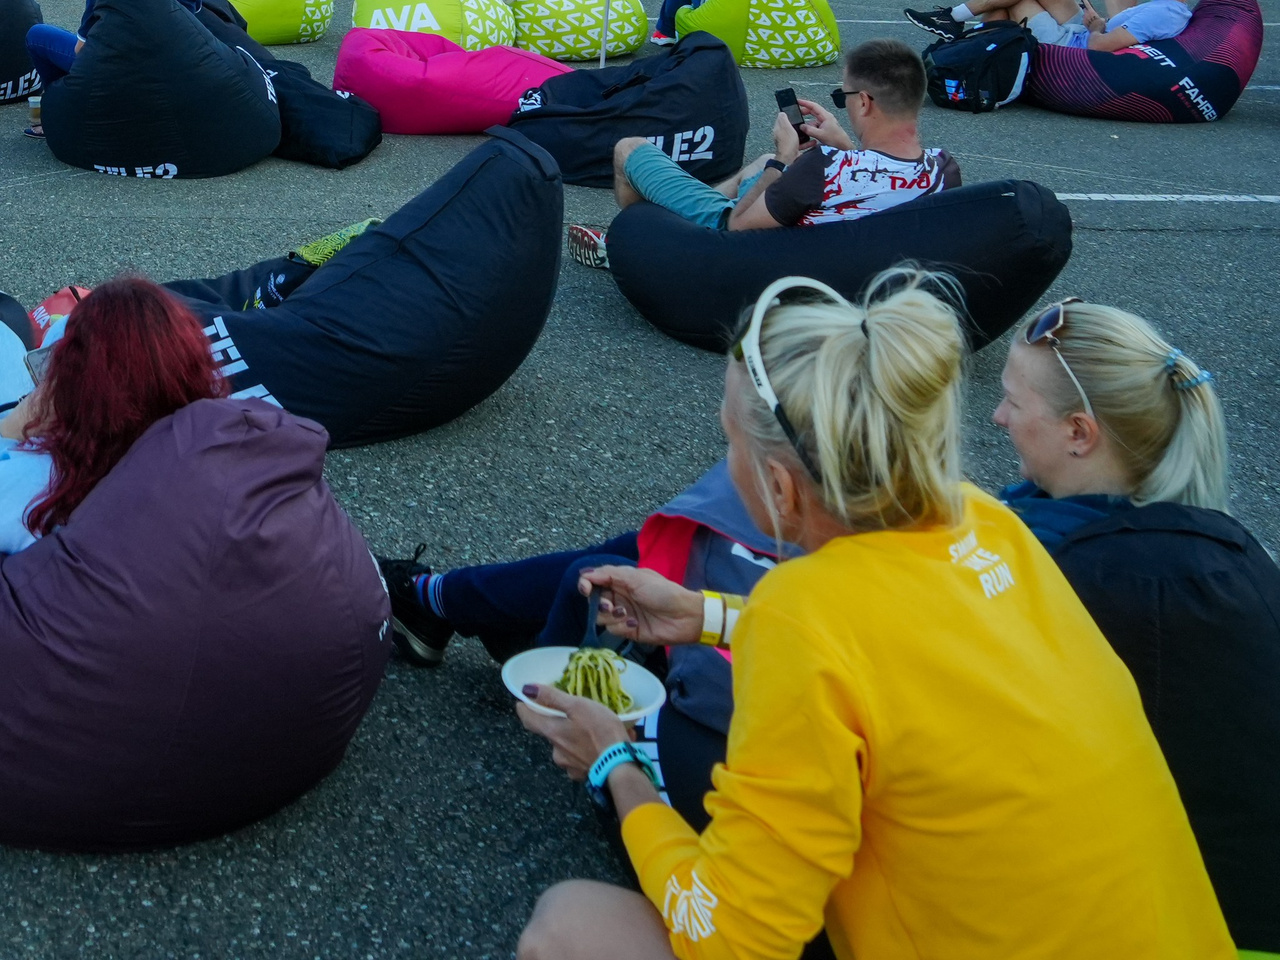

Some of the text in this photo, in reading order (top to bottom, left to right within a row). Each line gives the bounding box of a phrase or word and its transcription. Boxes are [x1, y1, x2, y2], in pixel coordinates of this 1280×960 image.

[370, 3, 441, 31] AVA
[32, 305, 51, 330] AVA
[978, 562, 1015, 599] RUN
